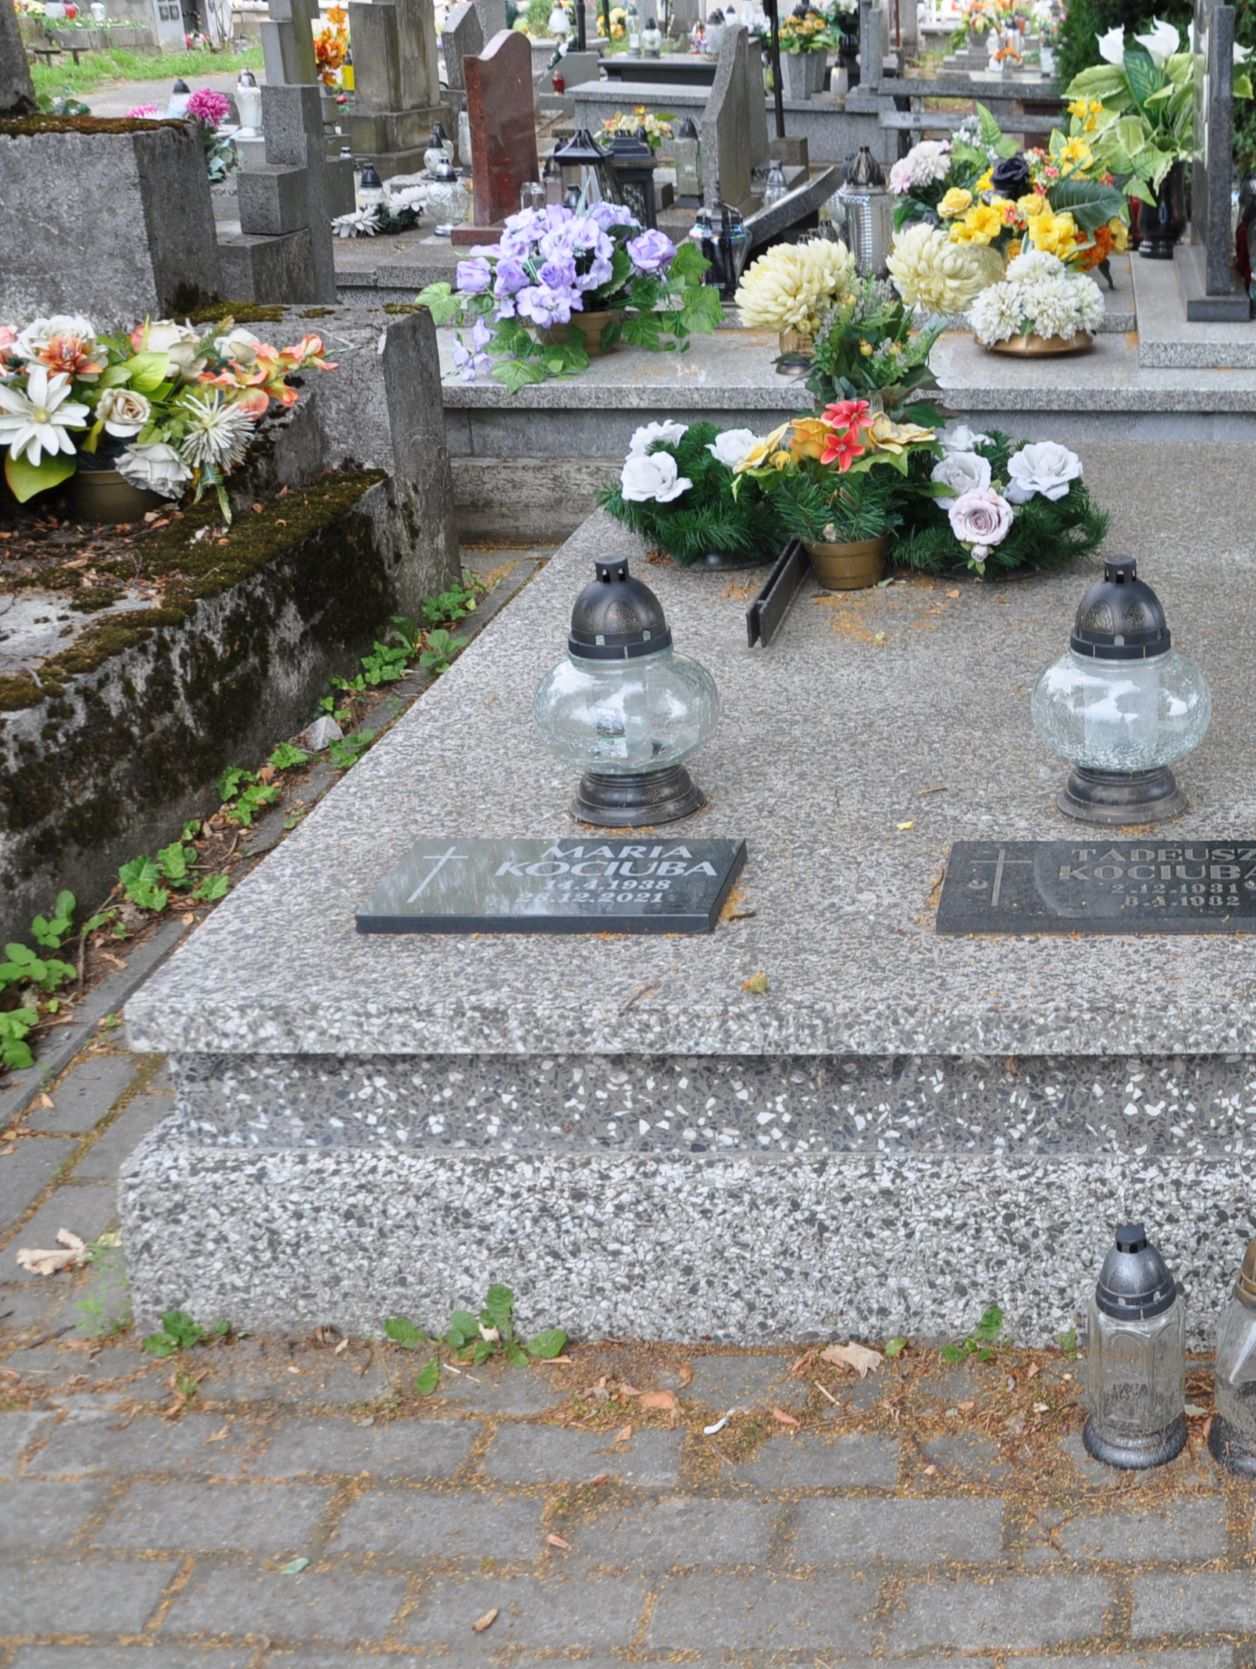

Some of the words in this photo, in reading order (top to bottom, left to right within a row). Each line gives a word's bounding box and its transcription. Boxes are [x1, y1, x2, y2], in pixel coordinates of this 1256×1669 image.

[540, 845, 692, 858] MARIA
[494, 861, 718, 876] KOCIUBA
[544, 879, 671, 890] 14.4.1938
